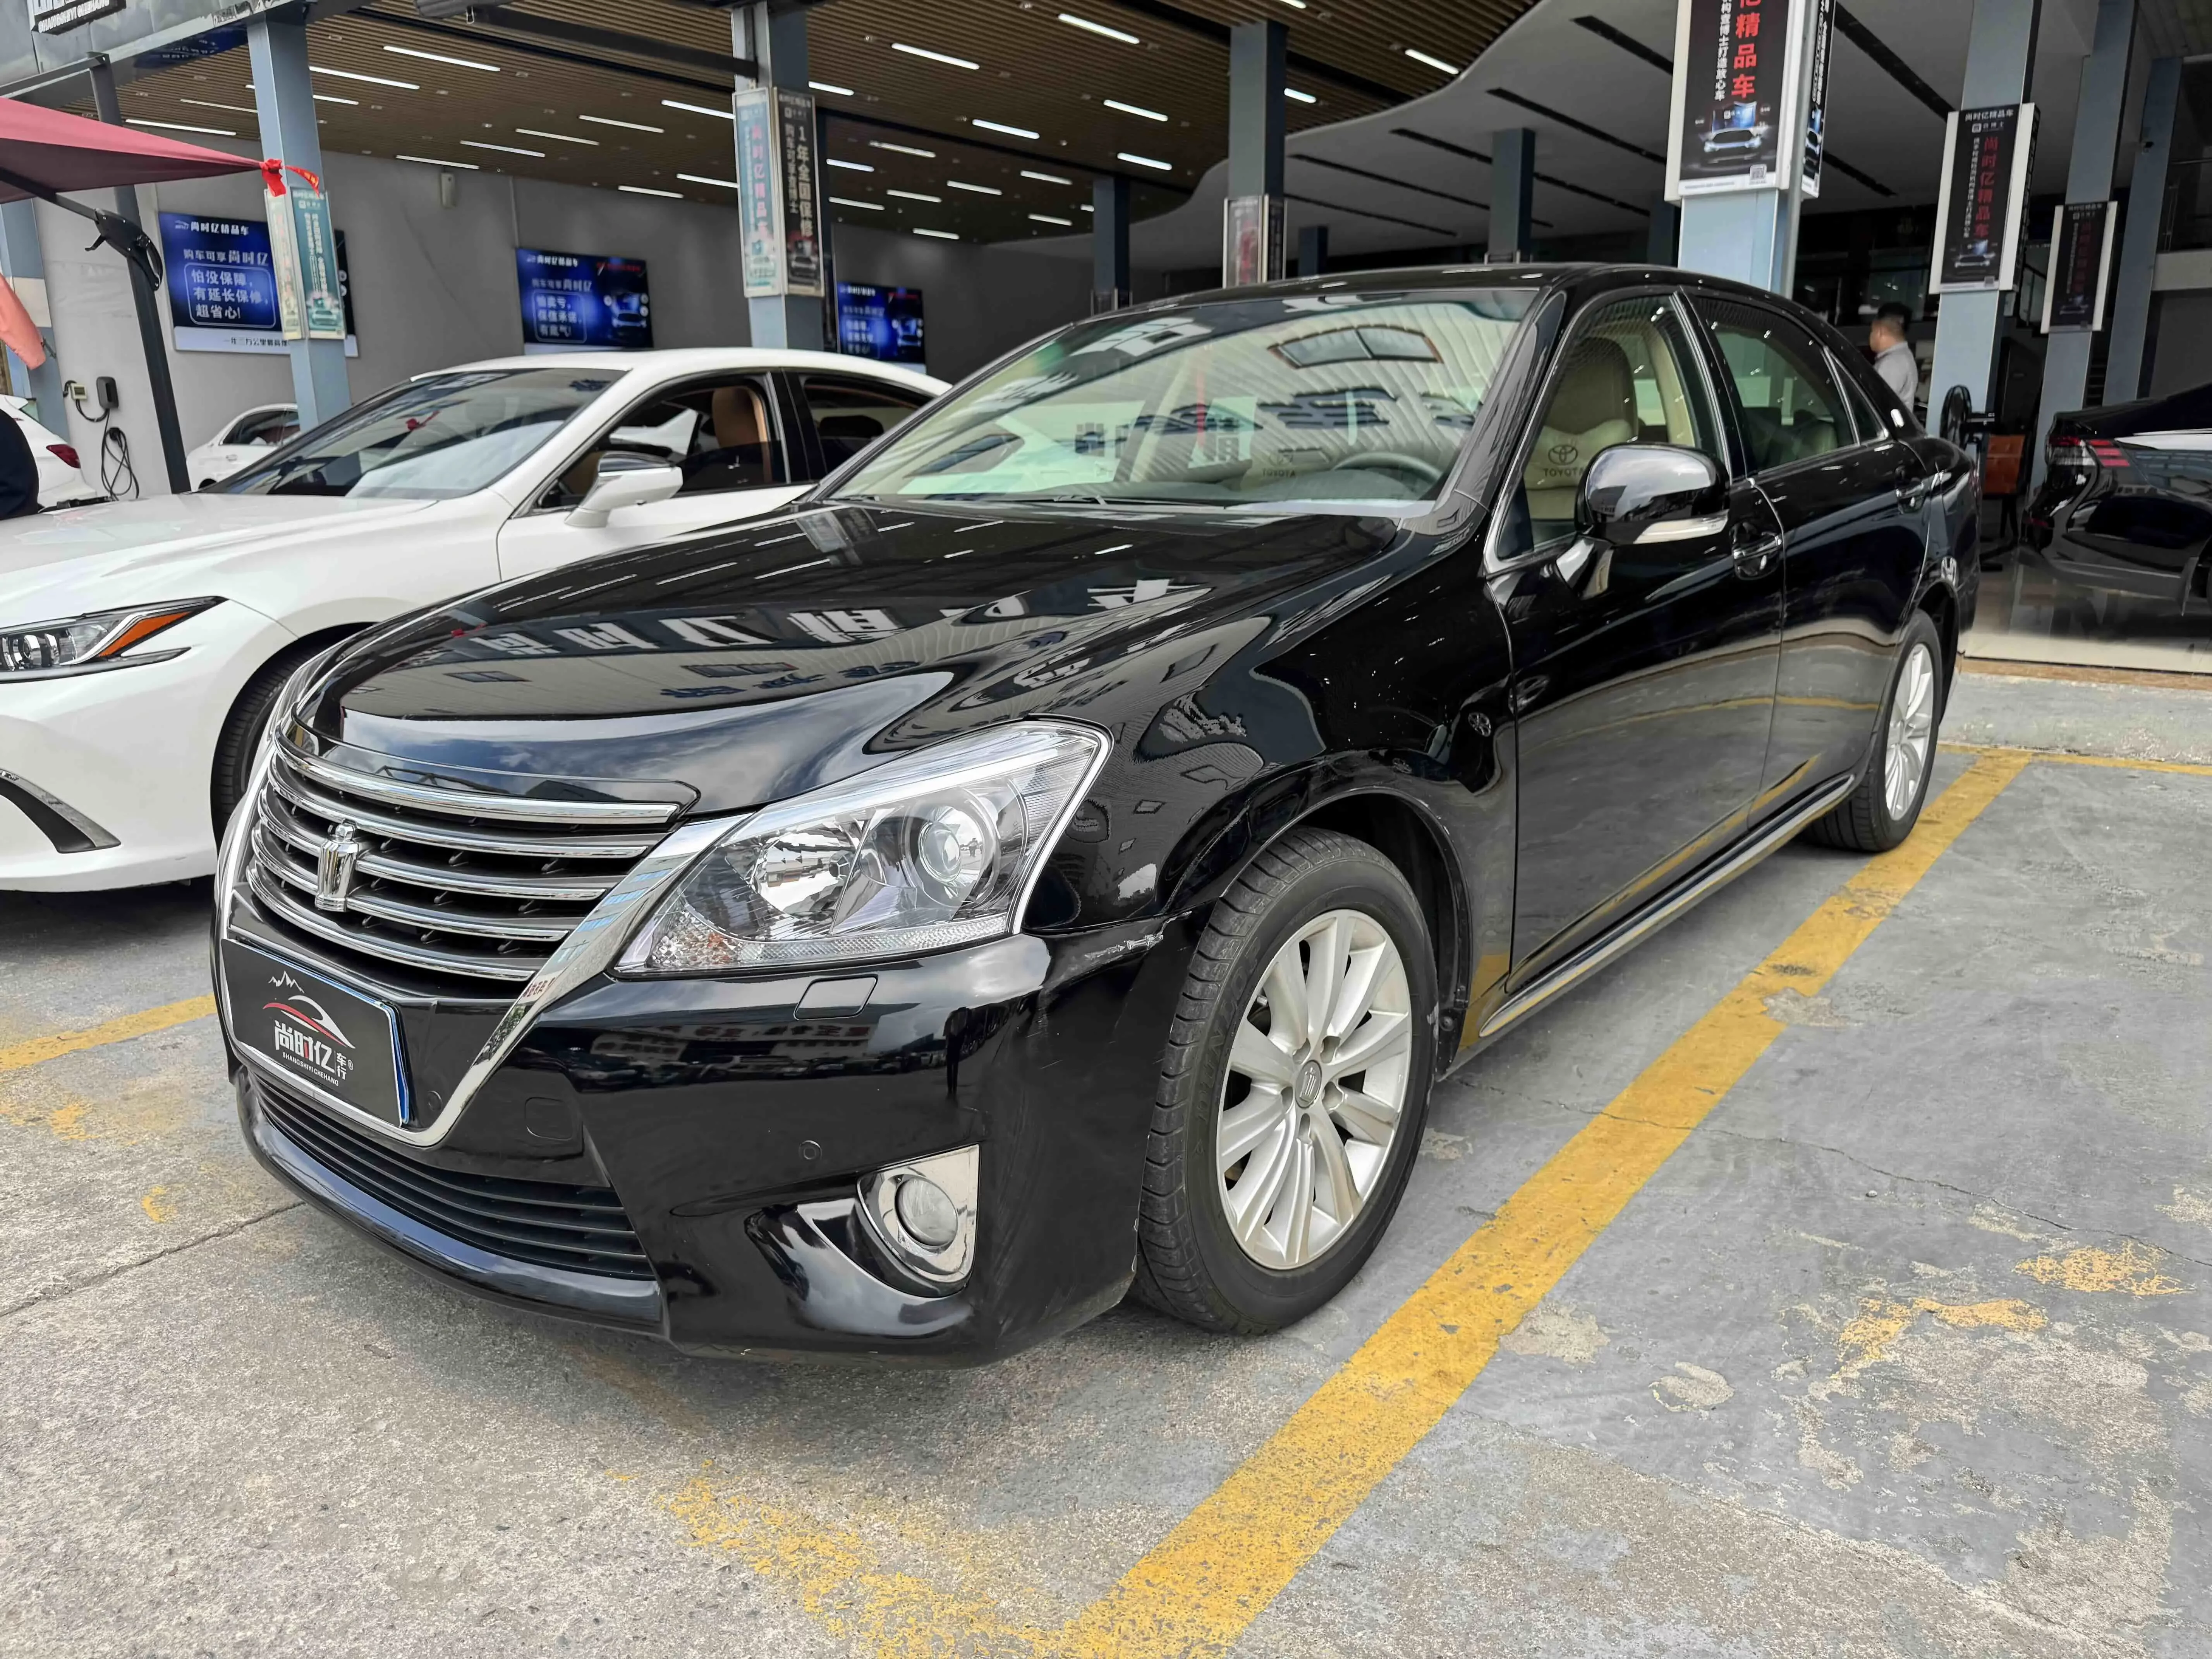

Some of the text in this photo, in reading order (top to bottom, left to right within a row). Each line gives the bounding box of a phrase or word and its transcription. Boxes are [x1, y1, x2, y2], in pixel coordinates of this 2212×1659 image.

[191, 222, 249, 235] 尚时亿精品车
[275, 1020, 335, 1073] 尚时亿
[283, 1052, 339, 1086] SHANGSHIYI CHEHANG
[337, 1053, 347, 1080] 车行
